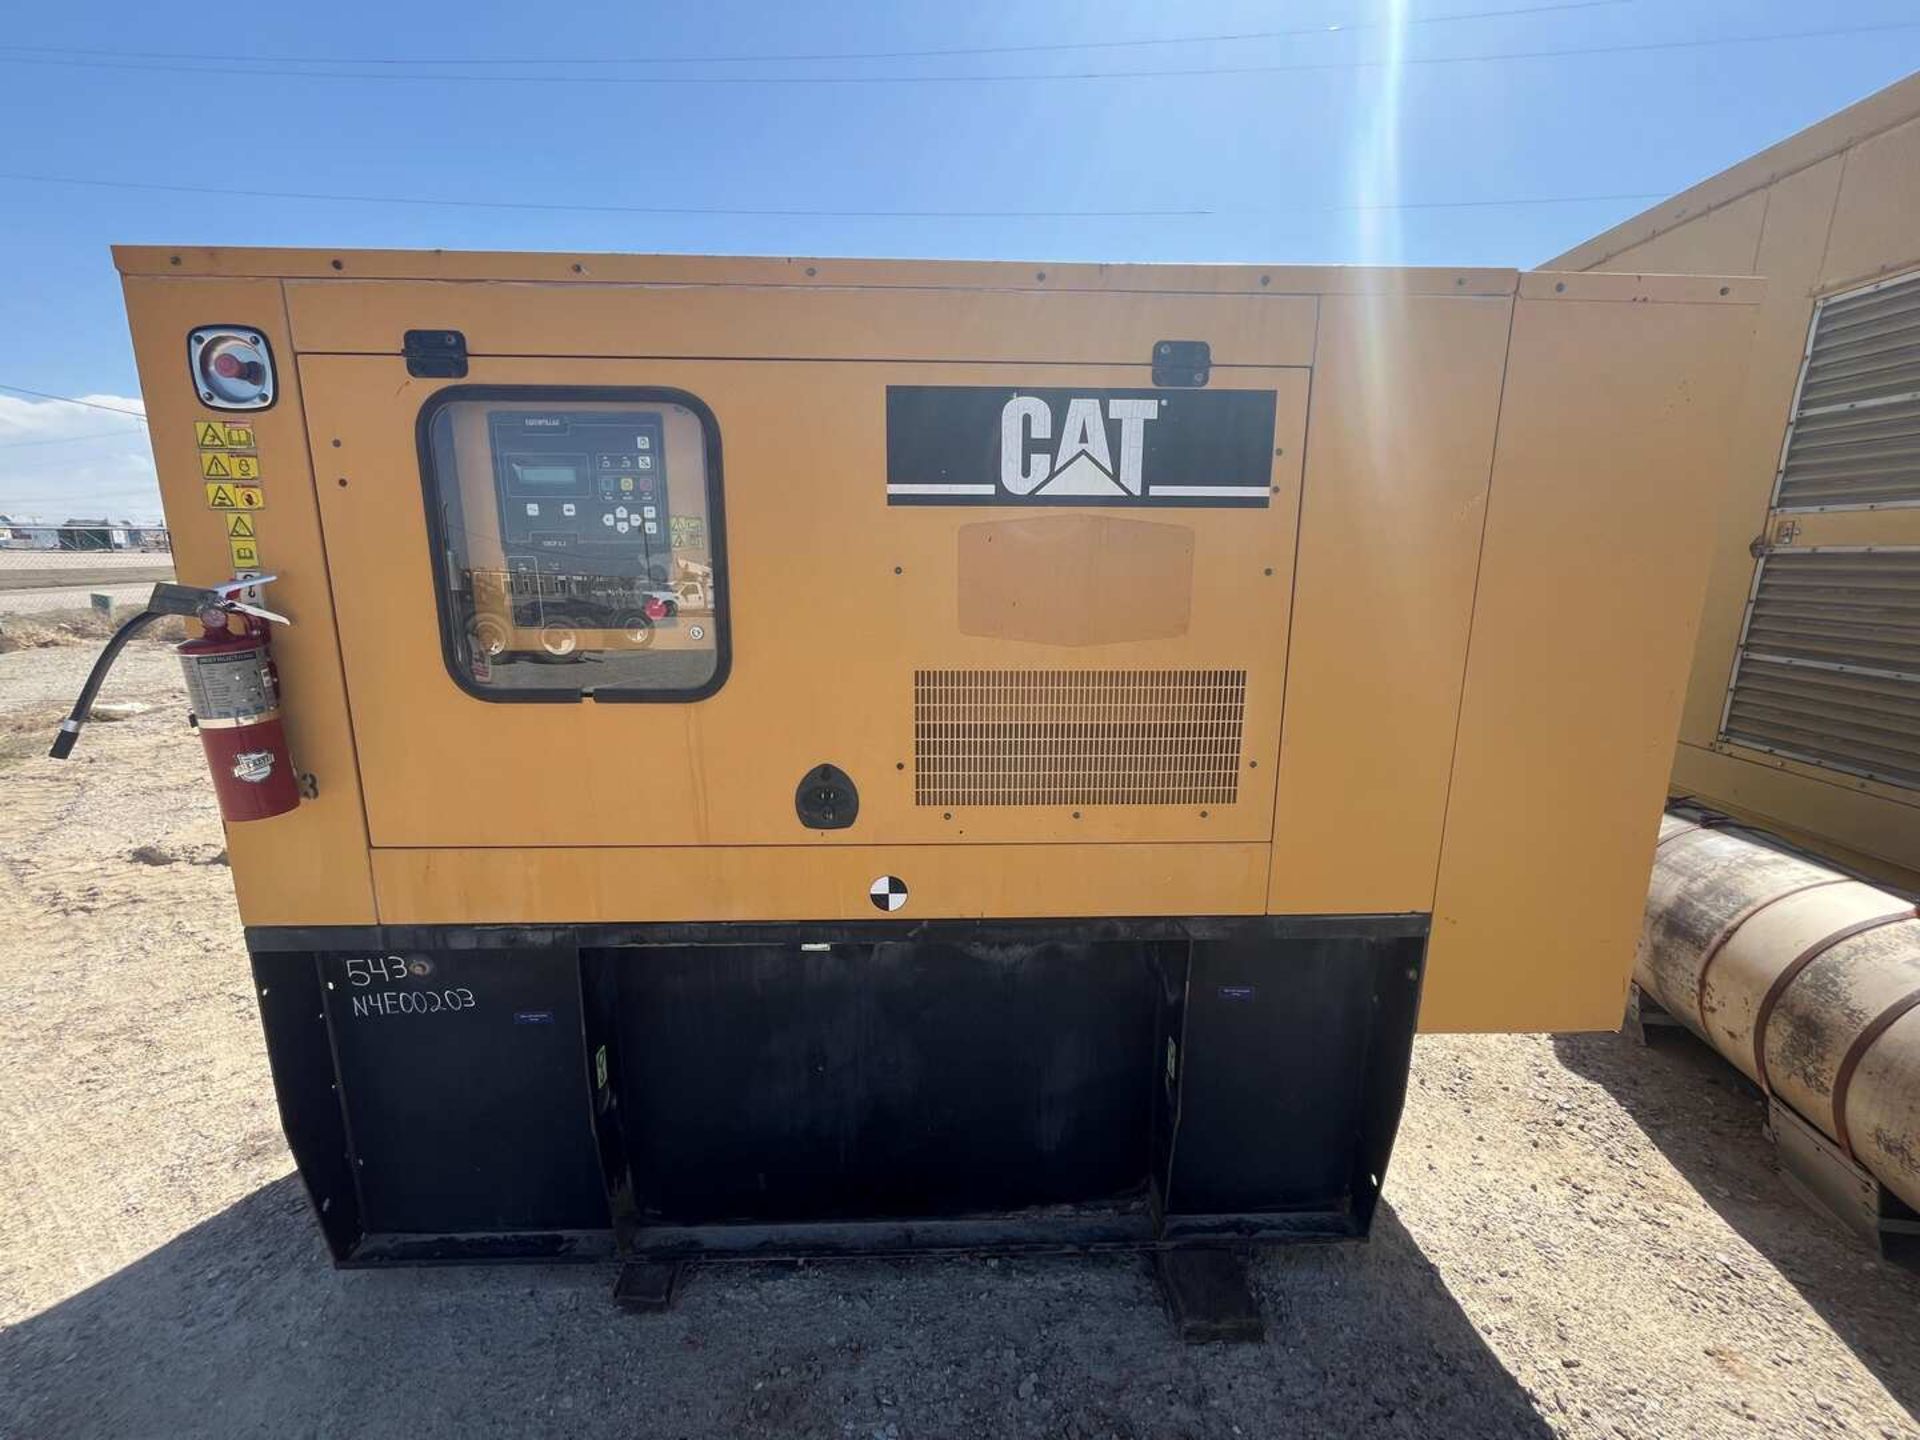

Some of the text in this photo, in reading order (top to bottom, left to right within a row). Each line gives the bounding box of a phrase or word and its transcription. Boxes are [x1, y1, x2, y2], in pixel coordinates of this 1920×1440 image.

[1001, 396, 1158, 496] CAT
[346, 955, 408, 986] 543
[352, 988, 476, 1016] N4E00203
